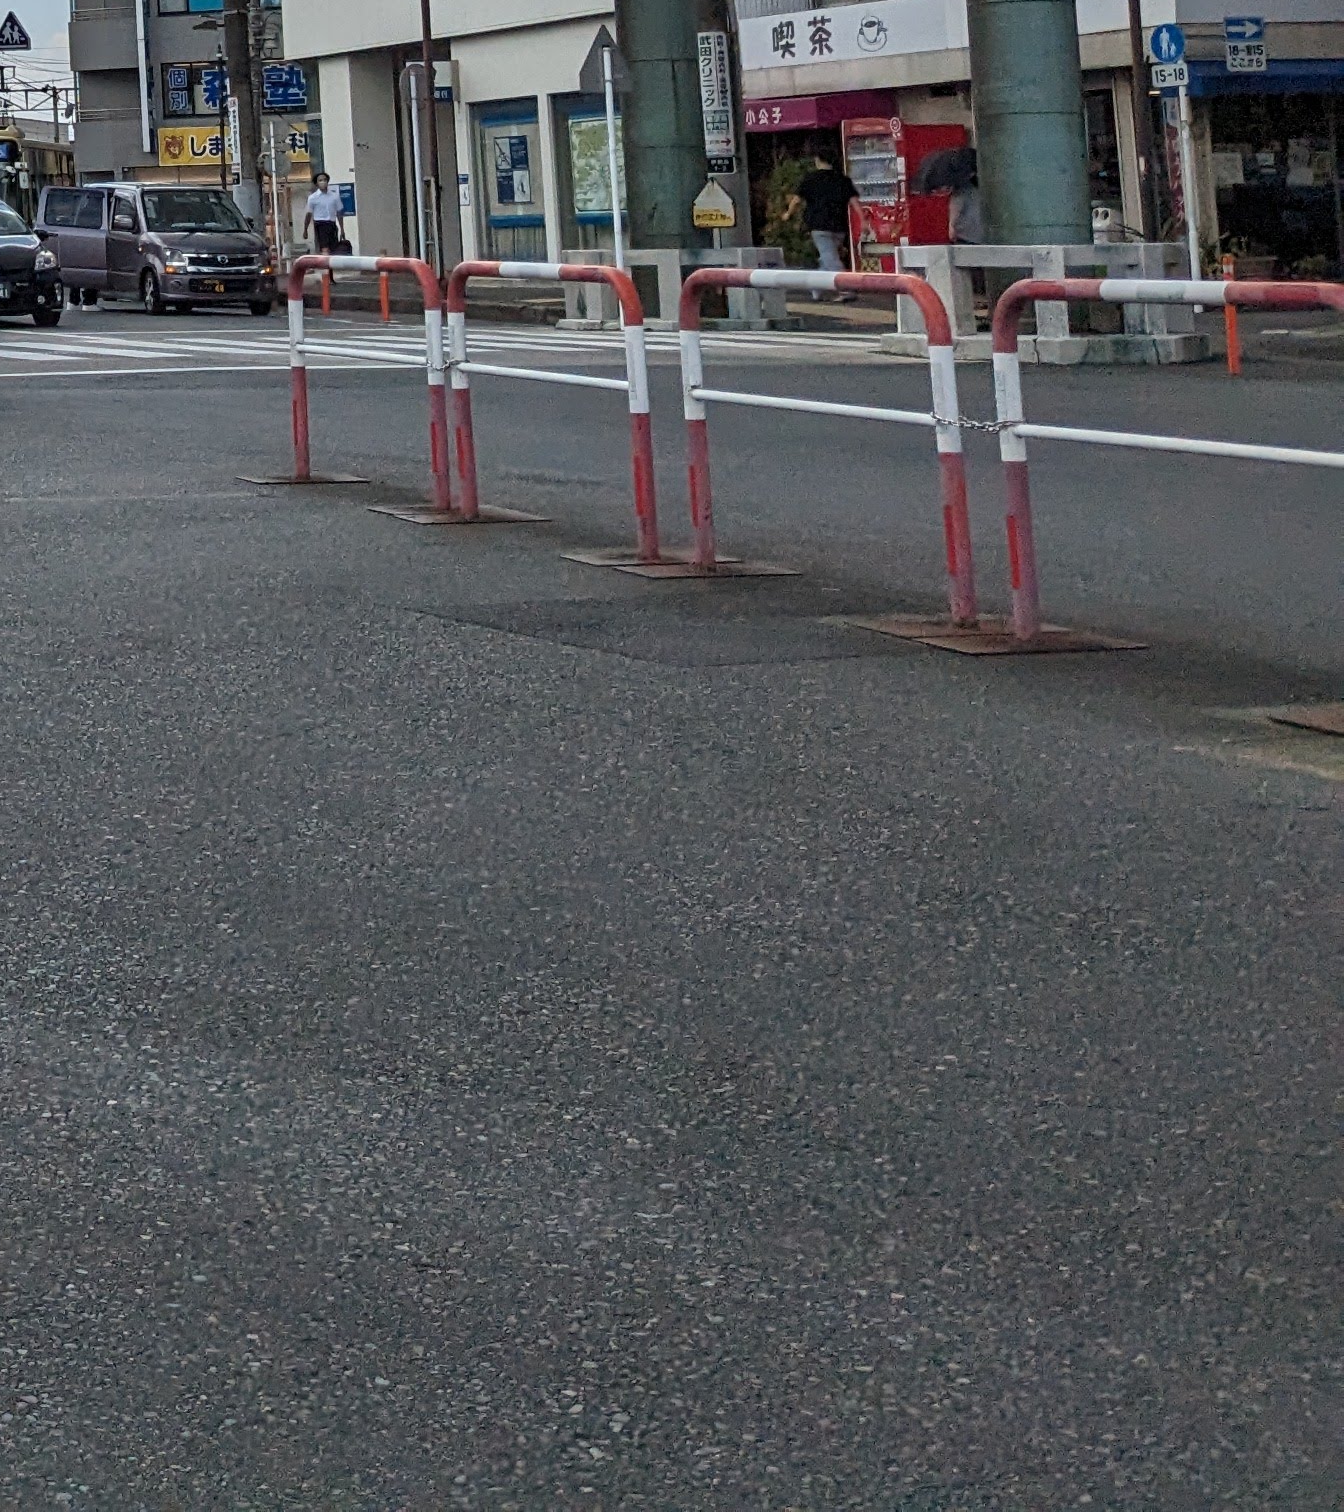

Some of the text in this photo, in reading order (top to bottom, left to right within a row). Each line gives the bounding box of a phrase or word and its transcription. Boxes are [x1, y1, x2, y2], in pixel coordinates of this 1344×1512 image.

[772, 15, 834, 59] 喫茶
[1154, 67, 1185, 84] 15-18
[745, 106, 783, 126] 小公子
